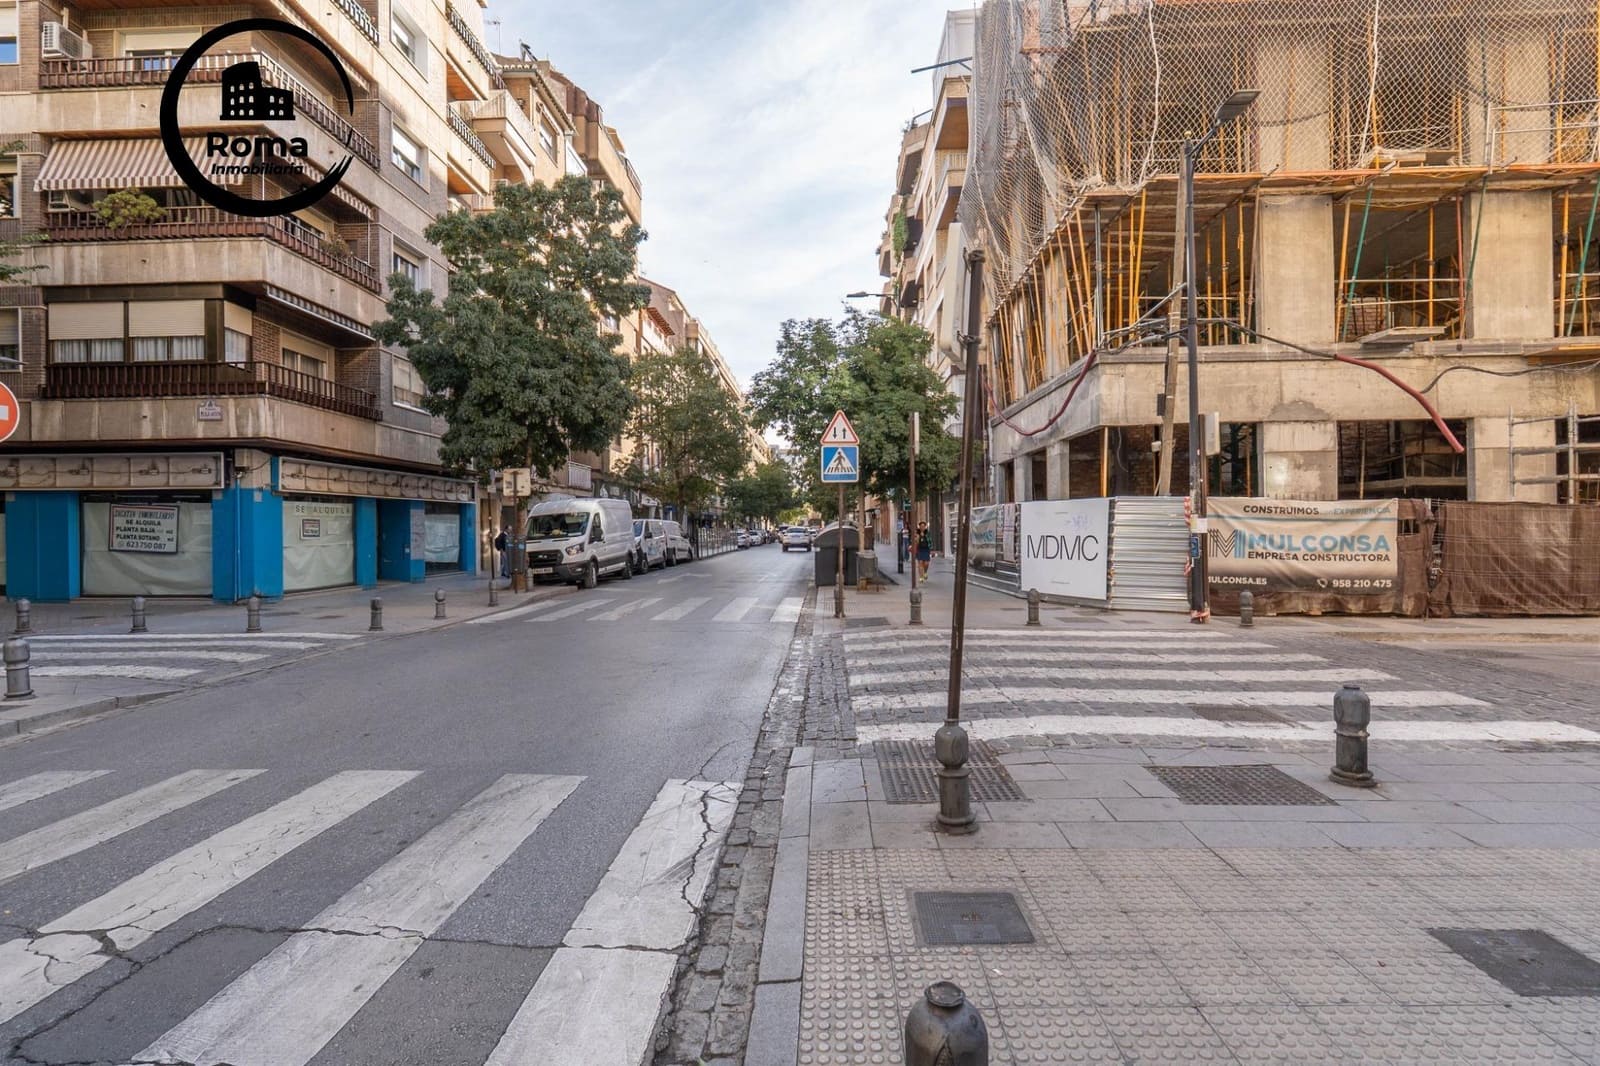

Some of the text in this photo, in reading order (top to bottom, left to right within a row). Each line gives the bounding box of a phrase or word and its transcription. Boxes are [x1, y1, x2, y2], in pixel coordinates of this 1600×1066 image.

[295, 504, 351, 514] SE ALQUILA
[1243, 505, 1320, 515] CONSTRUIMOS
[1027, 534, 1099, 562] MDMC
[1249, 534, 1390, 553] MULCONSA
[1248, 551, 1391, 562] EMPRESA CONSTRUCTORA
[1332, 580, 1392, 588] 958 210 475
